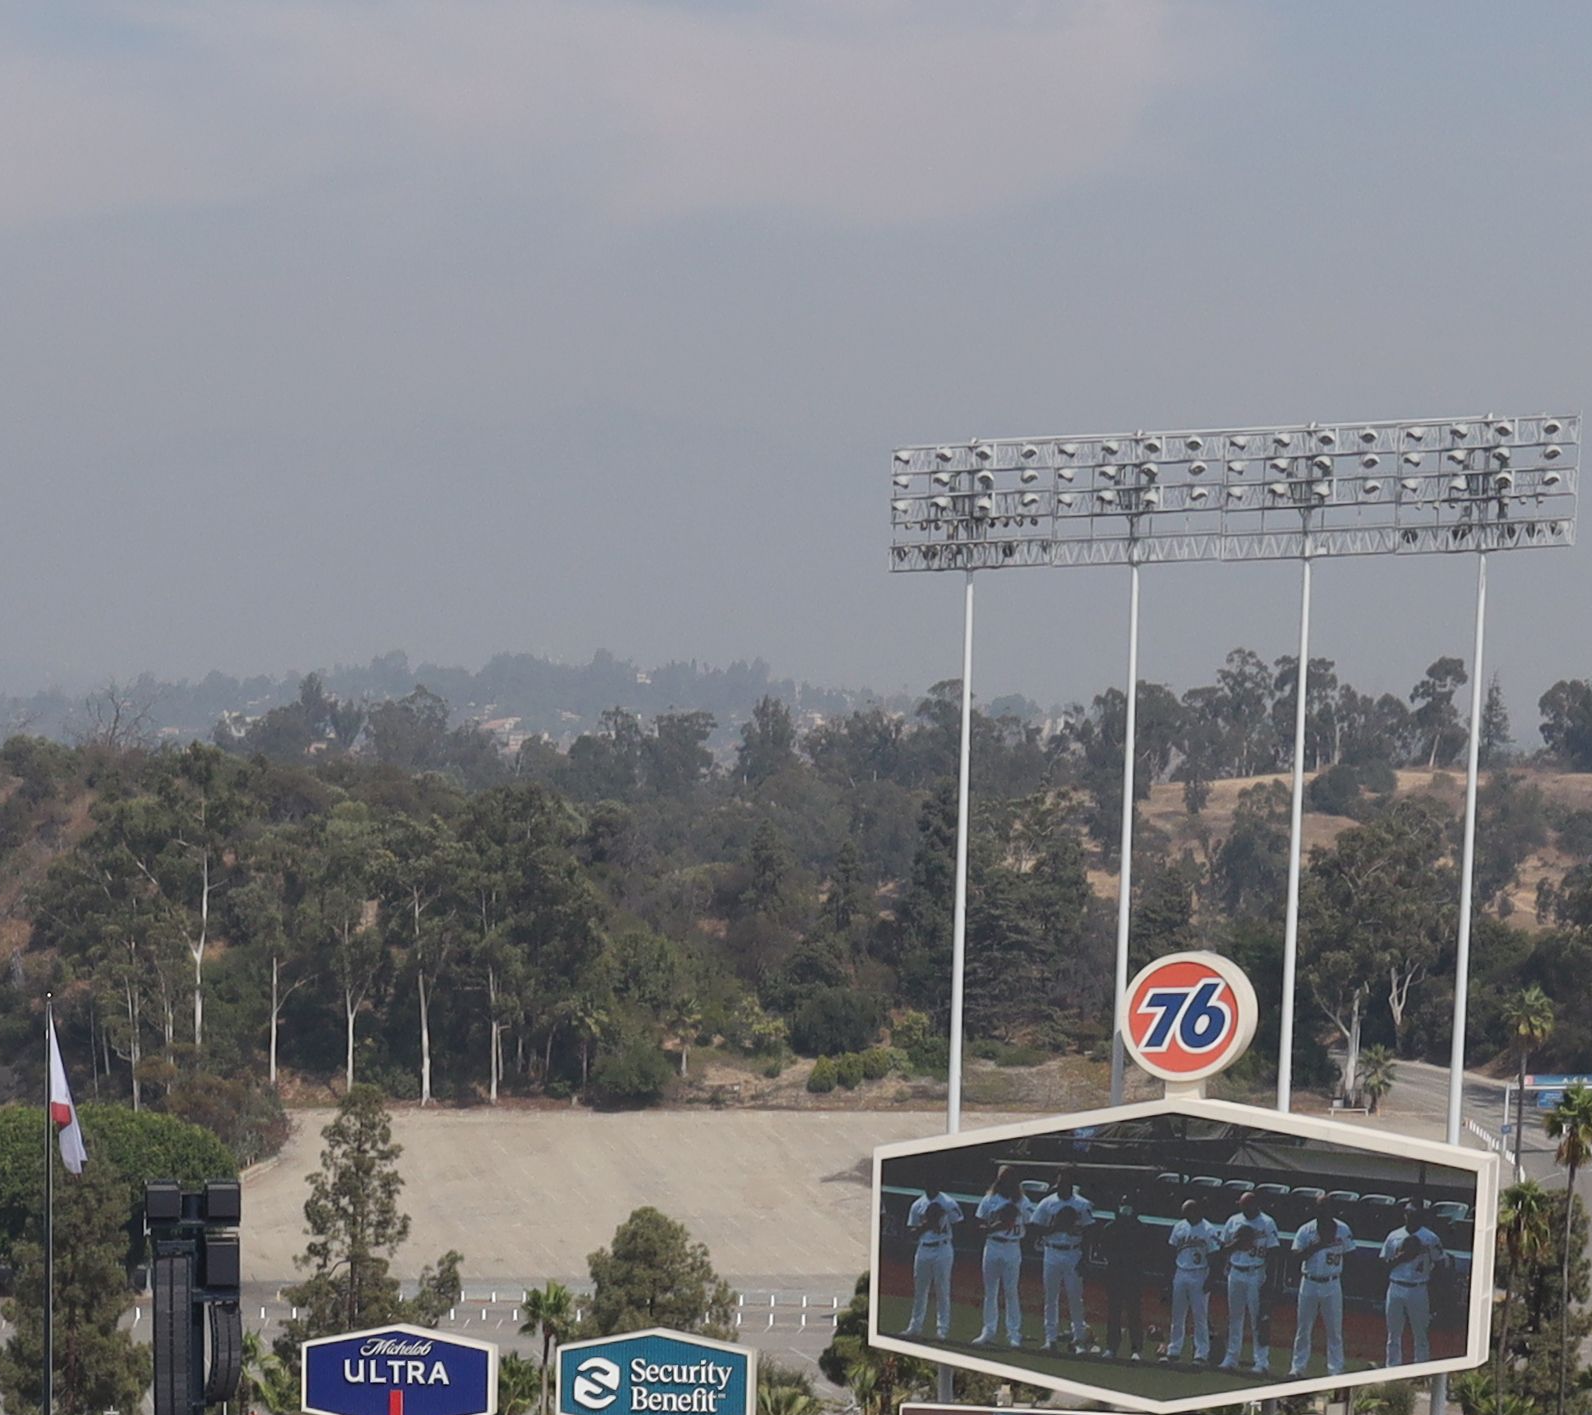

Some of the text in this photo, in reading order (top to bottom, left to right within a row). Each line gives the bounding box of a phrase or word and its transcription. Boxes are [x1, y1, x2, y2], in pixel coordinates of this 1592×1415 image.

[1139, 978, 1229, 1053] 76
[360, 1338, 434, 1356] Michelob
[344, 1359, 449, 1384] ULTRA
[630, 1358, 732, 1388] Security
[630, 1385, 718, 1412] Benefit
